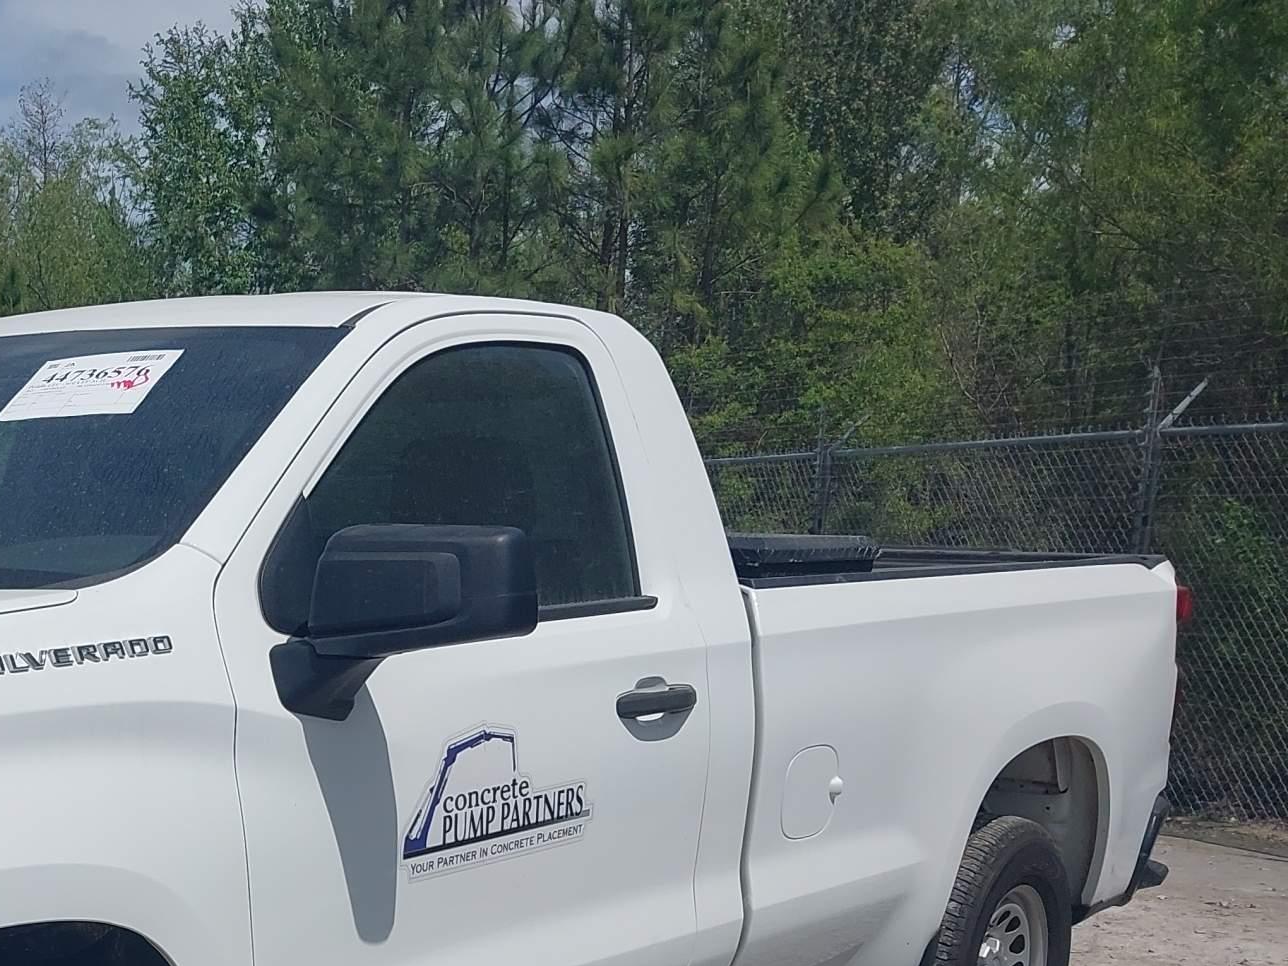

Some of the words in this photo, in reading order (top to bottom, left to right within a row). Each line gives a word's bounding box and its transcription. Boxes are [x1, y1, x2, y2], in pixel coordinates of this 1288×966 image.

[442, 806, 496, 845] PUMP
[500, 785, 584, 833] PARTNERS
[443, 778, 529, 813] concrete
